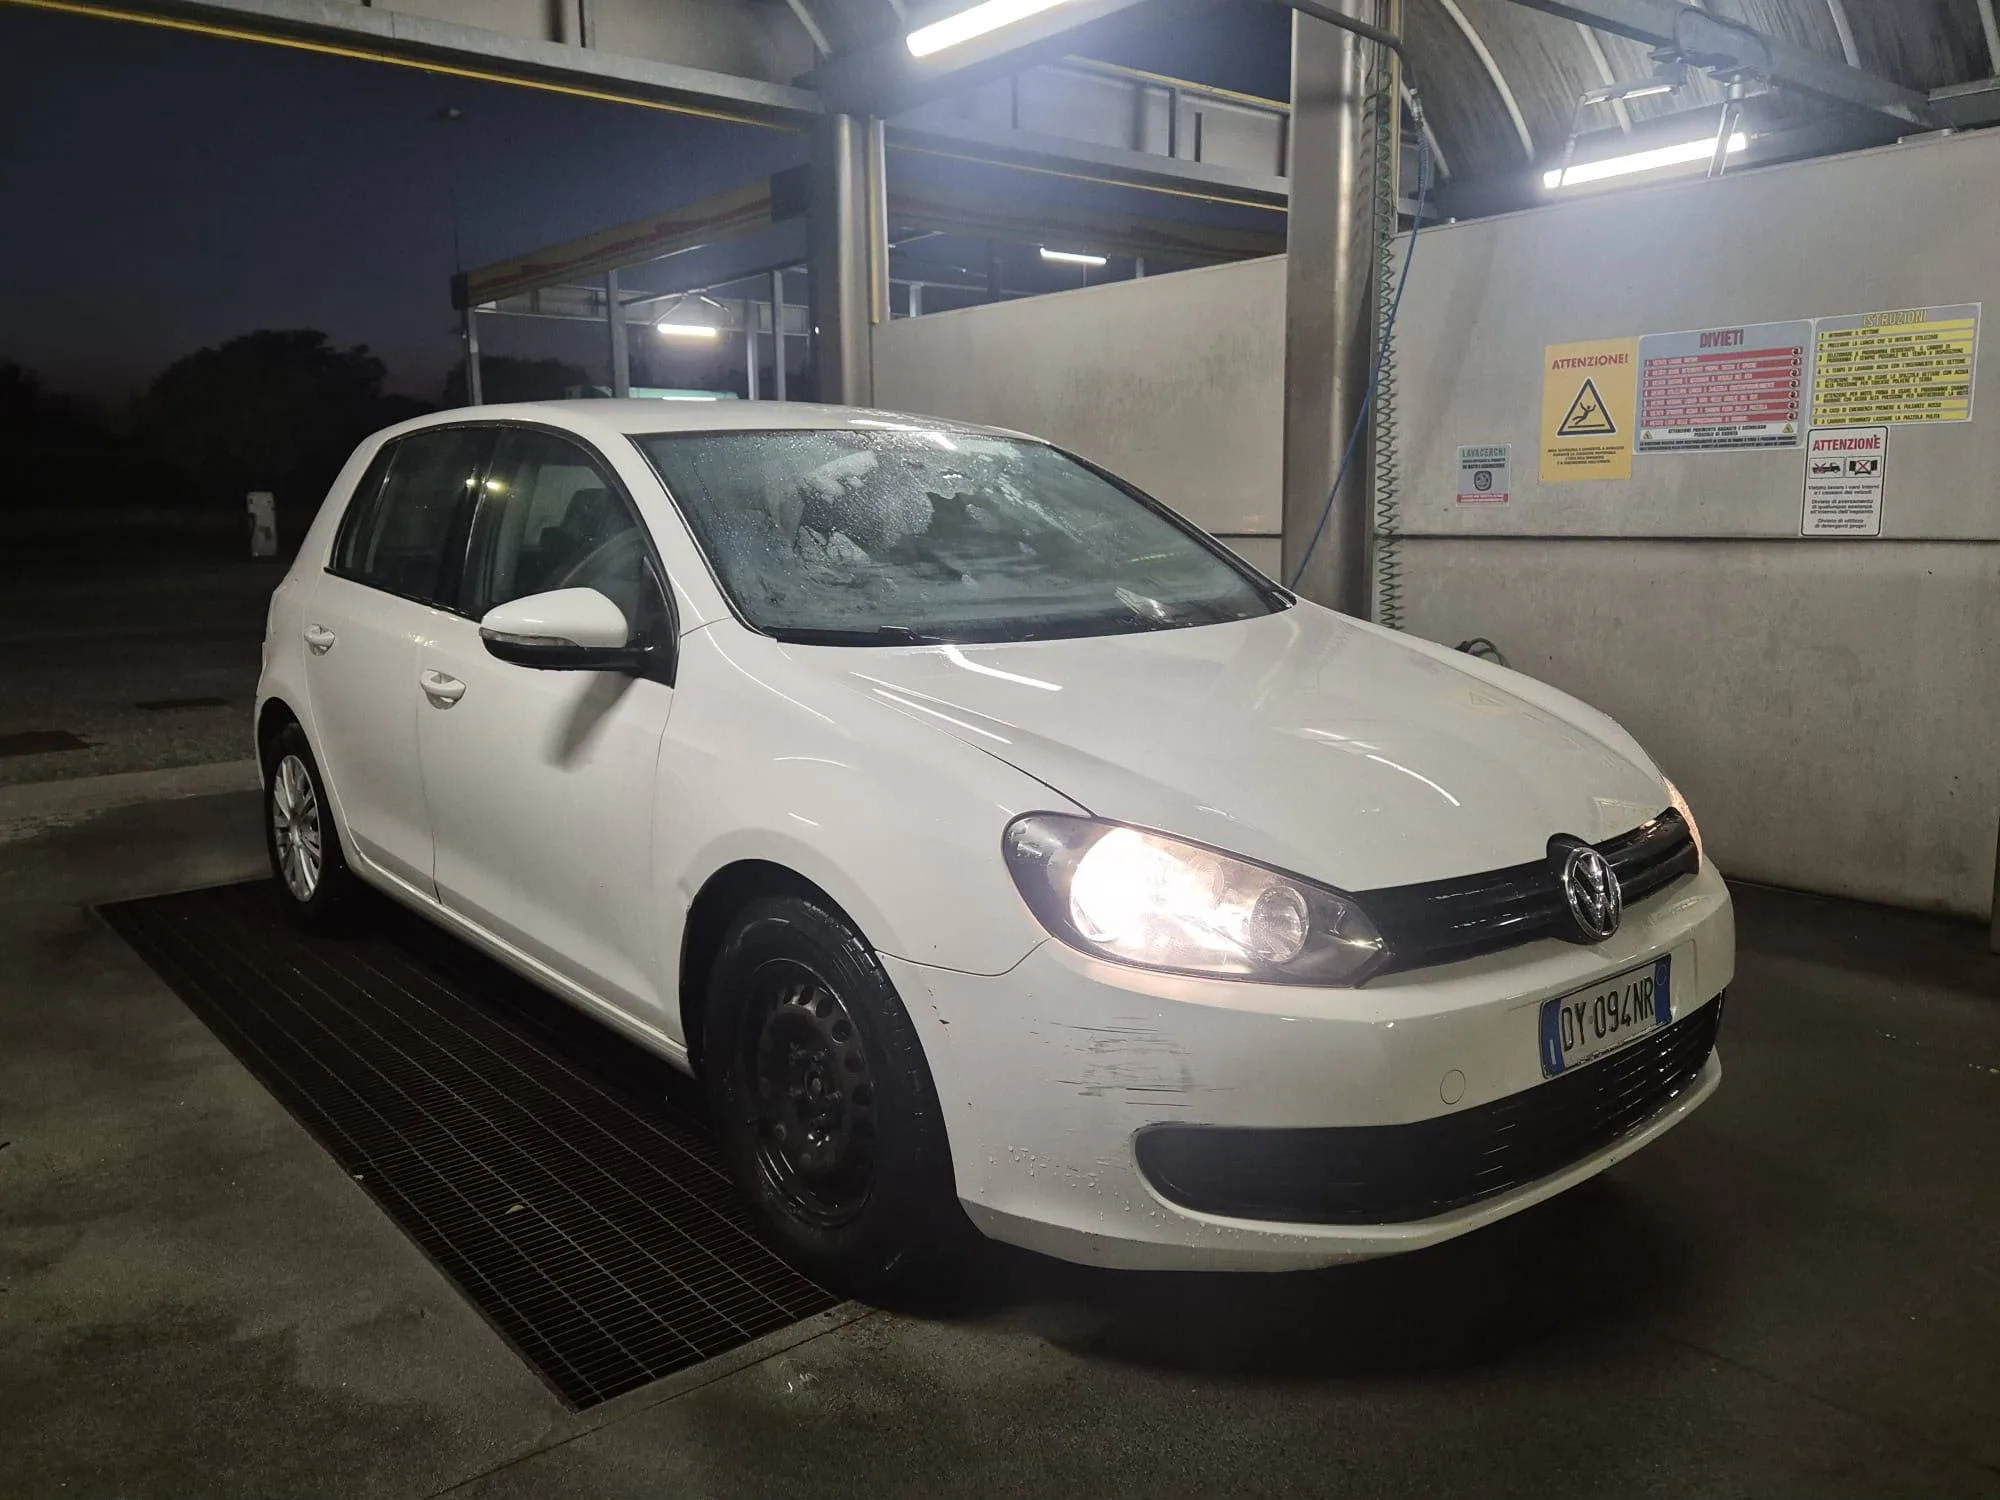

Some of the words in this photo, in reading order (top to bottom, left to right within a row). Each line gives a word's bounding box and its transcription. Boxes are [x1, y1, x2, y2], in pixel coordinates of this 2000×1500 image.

[1863, 309, 1928, 327] ISTRUZIONI
[1700, 329, 1744, 348] DIVIETI
[1552, 353, 1629, 370] ATTENZIONE!
[1561, 1001, 1587, 1052] DY
[1594, 976, 1655, 1039] 094NR
